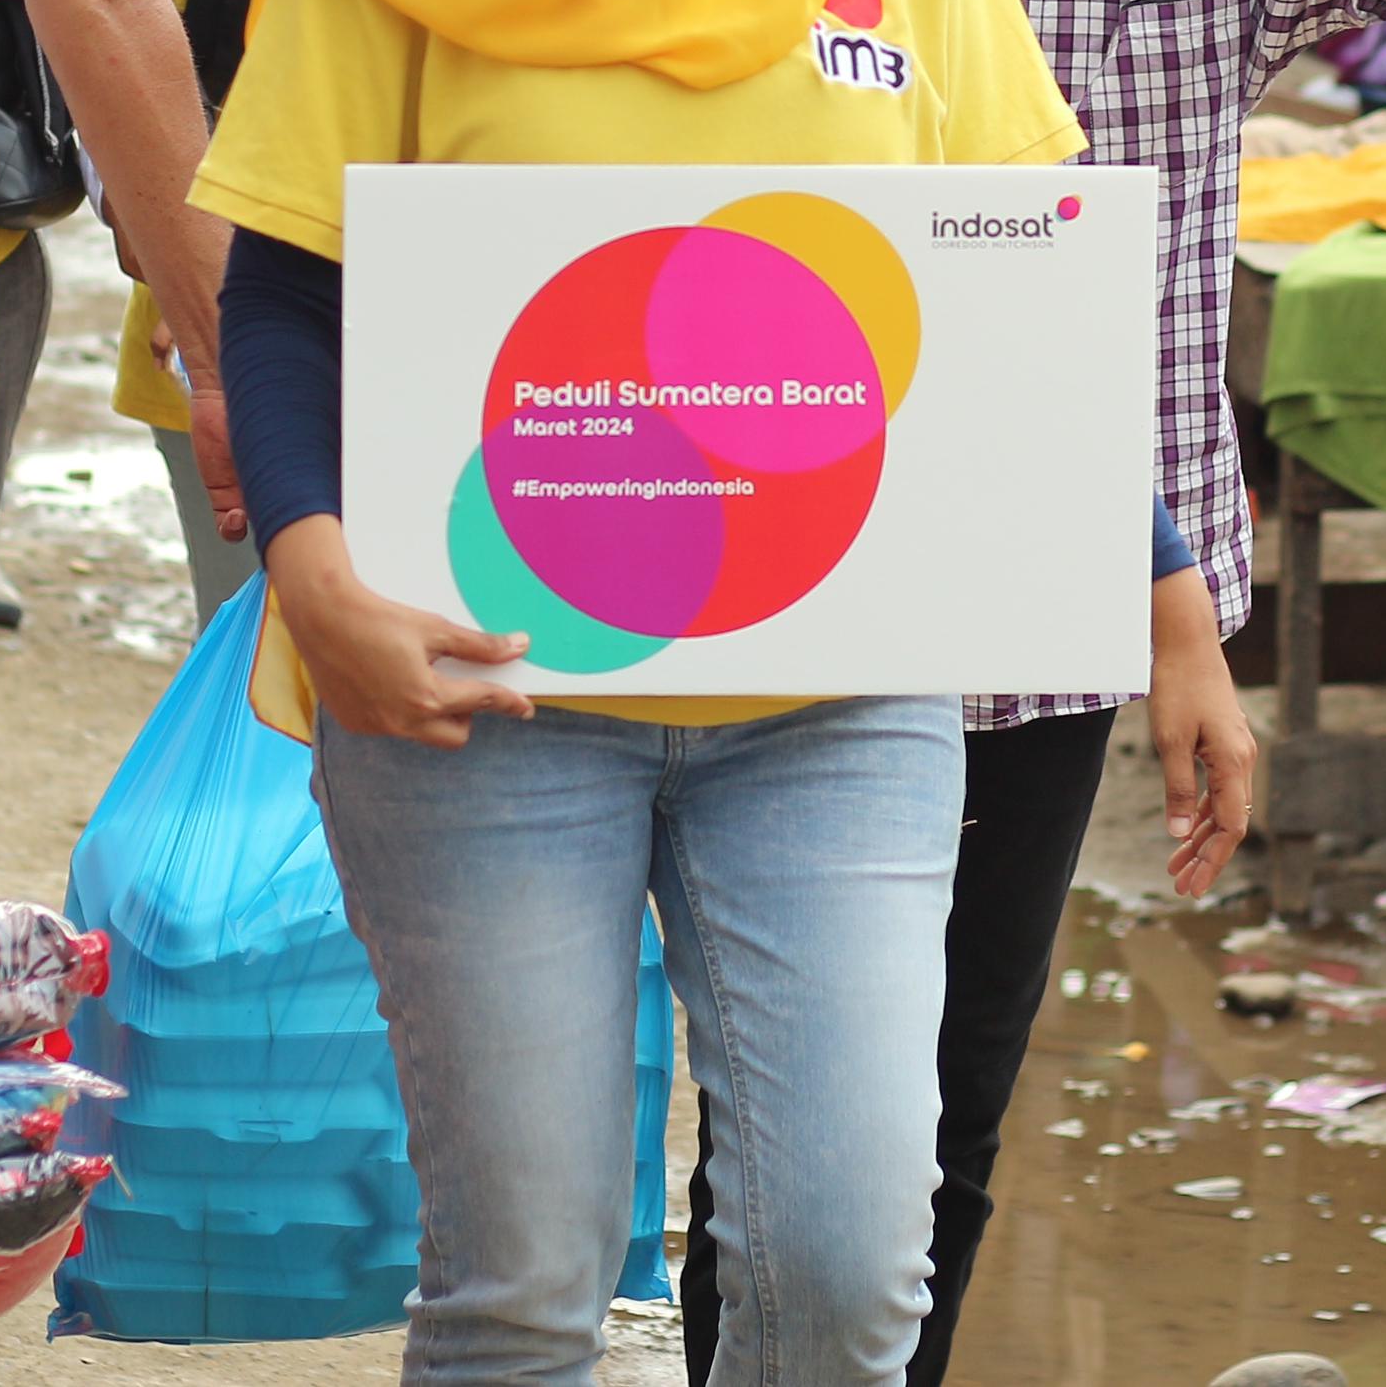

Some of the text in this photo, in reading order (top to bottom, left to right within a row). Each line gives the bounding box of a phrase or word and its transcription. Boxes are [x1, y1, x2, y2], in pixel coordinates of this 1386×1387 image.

[932, 211, 1054, 238] indosat
[514, 379, 867, 407] Peduli Sumatera Barat
[513, 417, 634, 437] Maret 2024
[513, 477, 755, 501] #EmpoweringIndonesia
